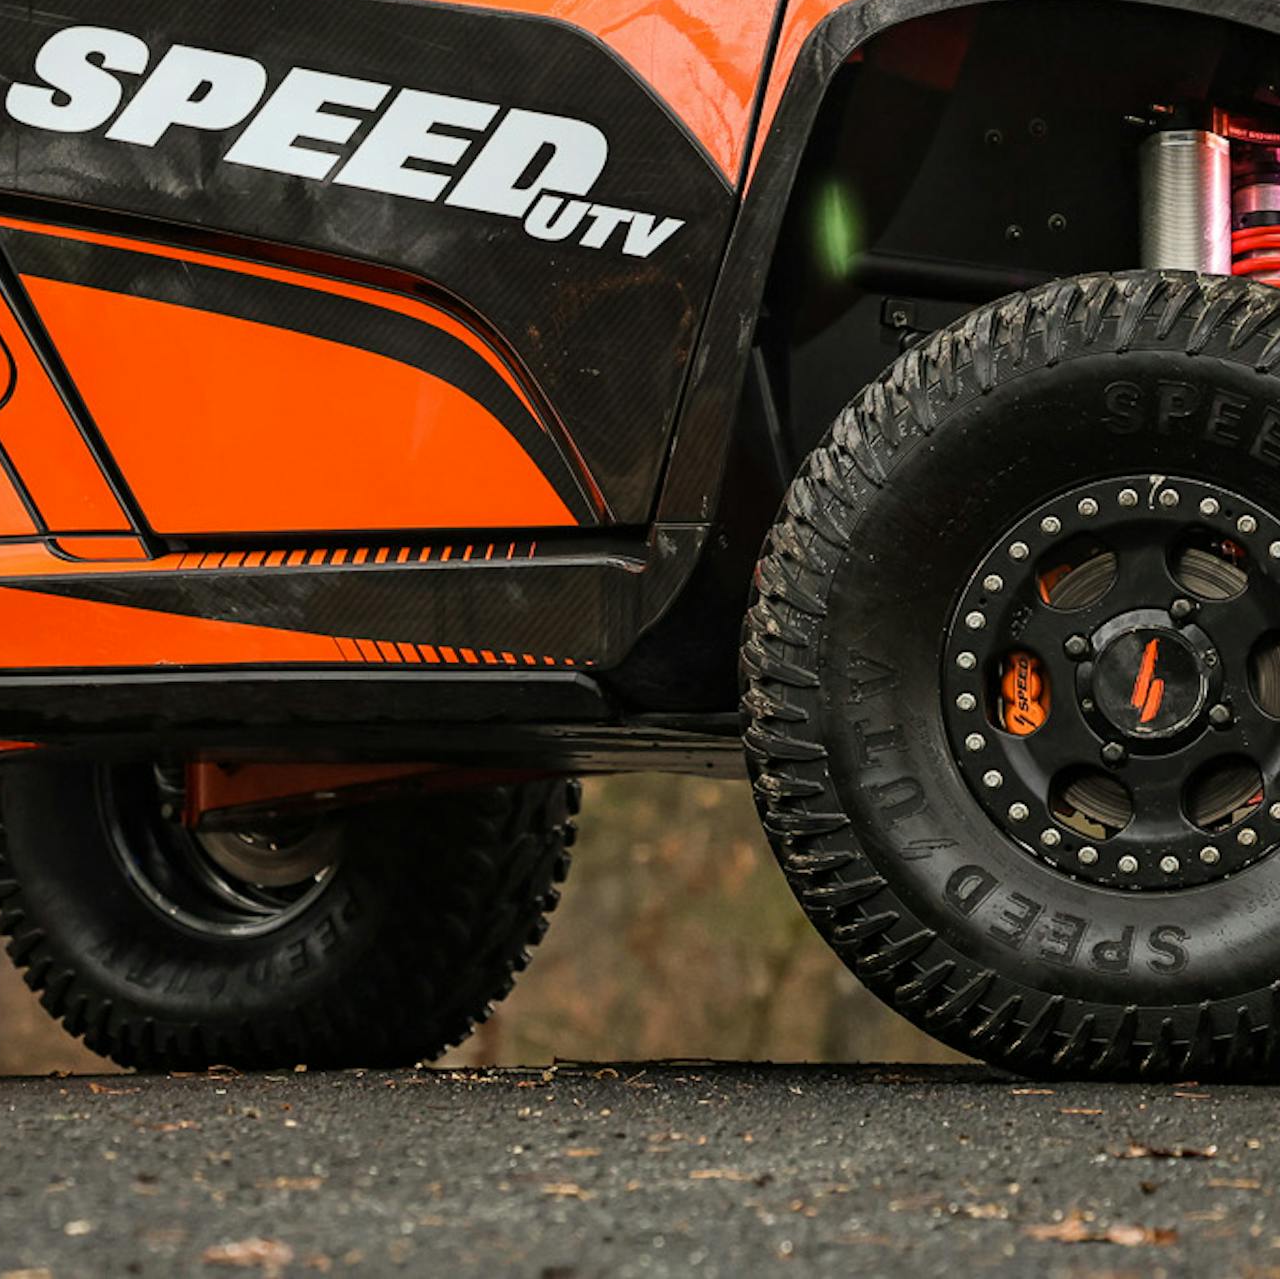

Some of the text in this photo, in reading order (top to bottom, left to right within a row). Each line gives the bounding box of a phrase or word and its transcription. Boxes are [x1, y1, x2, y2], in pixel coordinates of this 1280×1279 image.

[5, 25, 687, 258] SPEED UTV
[1016, 656, 1030, 712] SPEED
[845, 648, 1192, 975] SPEED UTV
